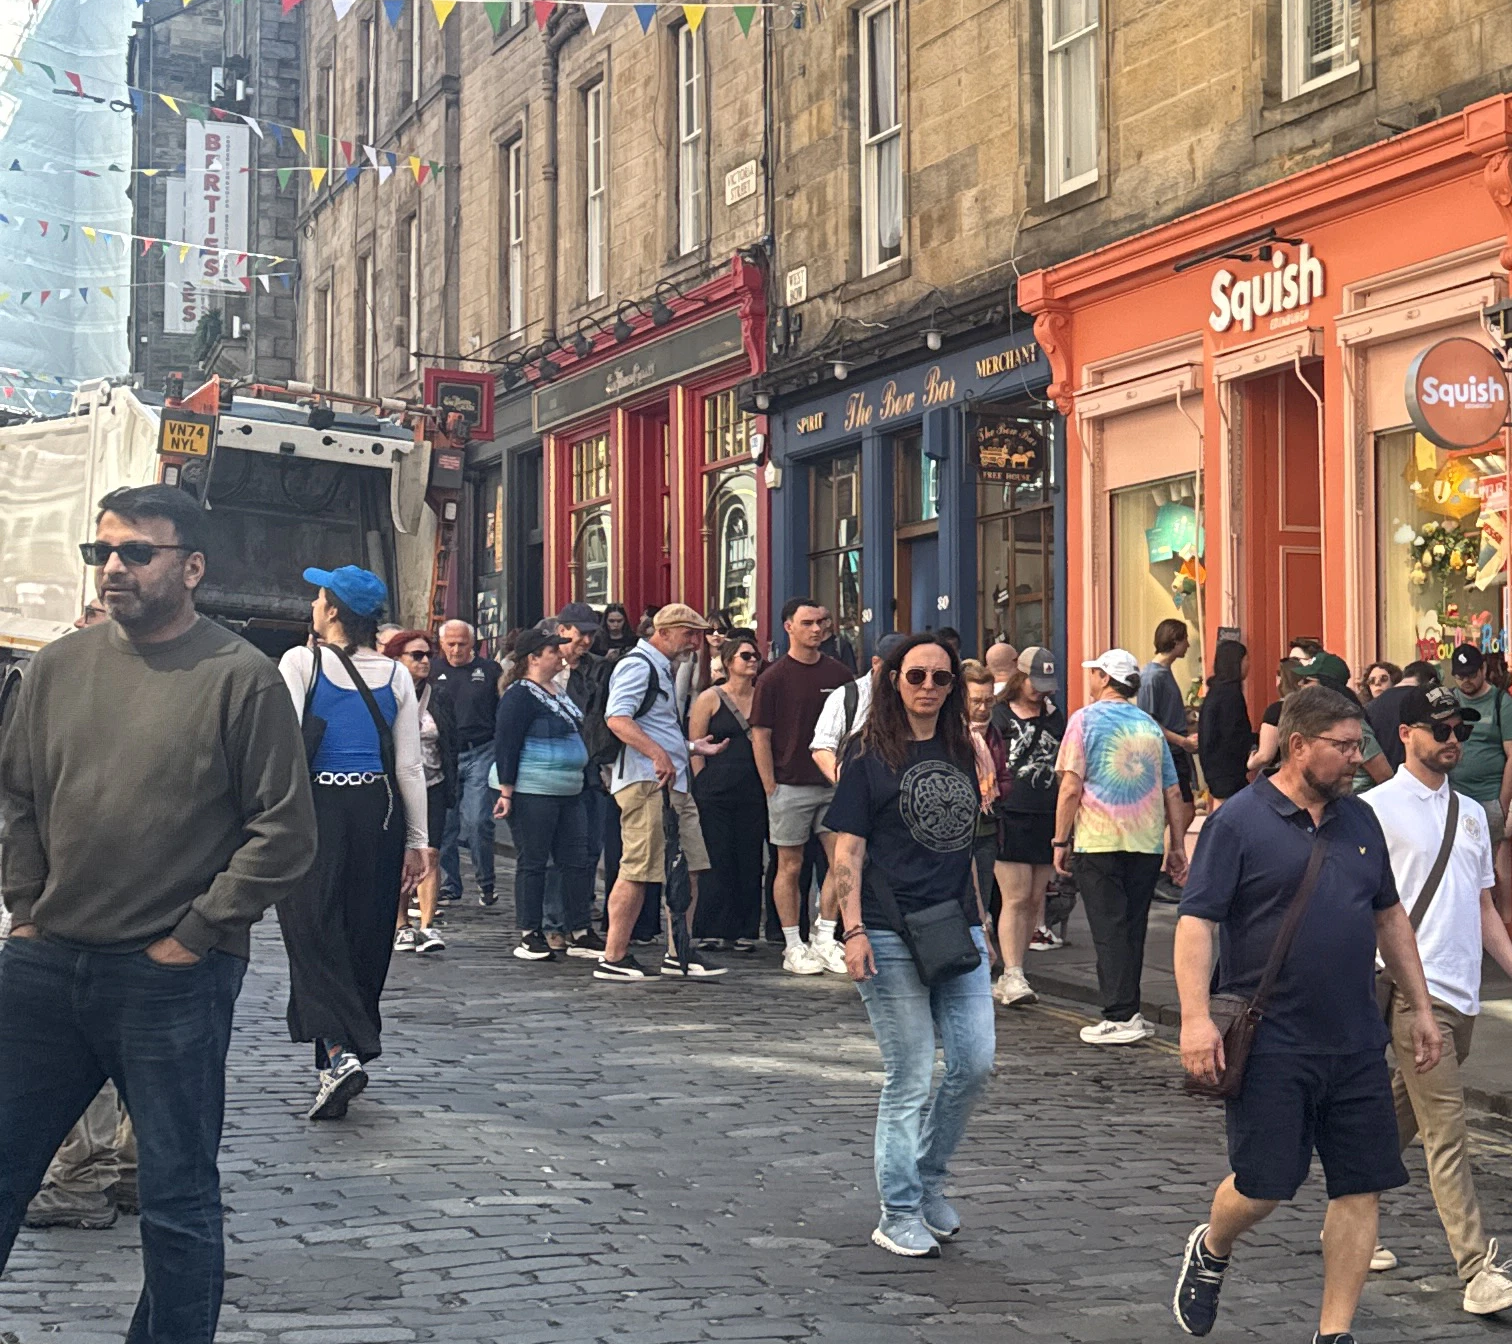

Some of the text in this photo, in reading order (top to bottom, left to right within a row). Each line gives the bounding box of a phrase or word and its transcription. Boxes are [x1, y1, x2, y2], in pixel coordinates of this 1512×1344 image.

[1208, 243, 1326, 332] Squish
[975, 342, 1037, 379] MERCHANT
[844, 366, 956, 432] The Bow Bar
[1422, 376, 1504, 408] Squish
[169, 422, 205, 439] VN74
[796, 412, 825, 435] SPIRIT
[171, 437, 198, 452] NYL
